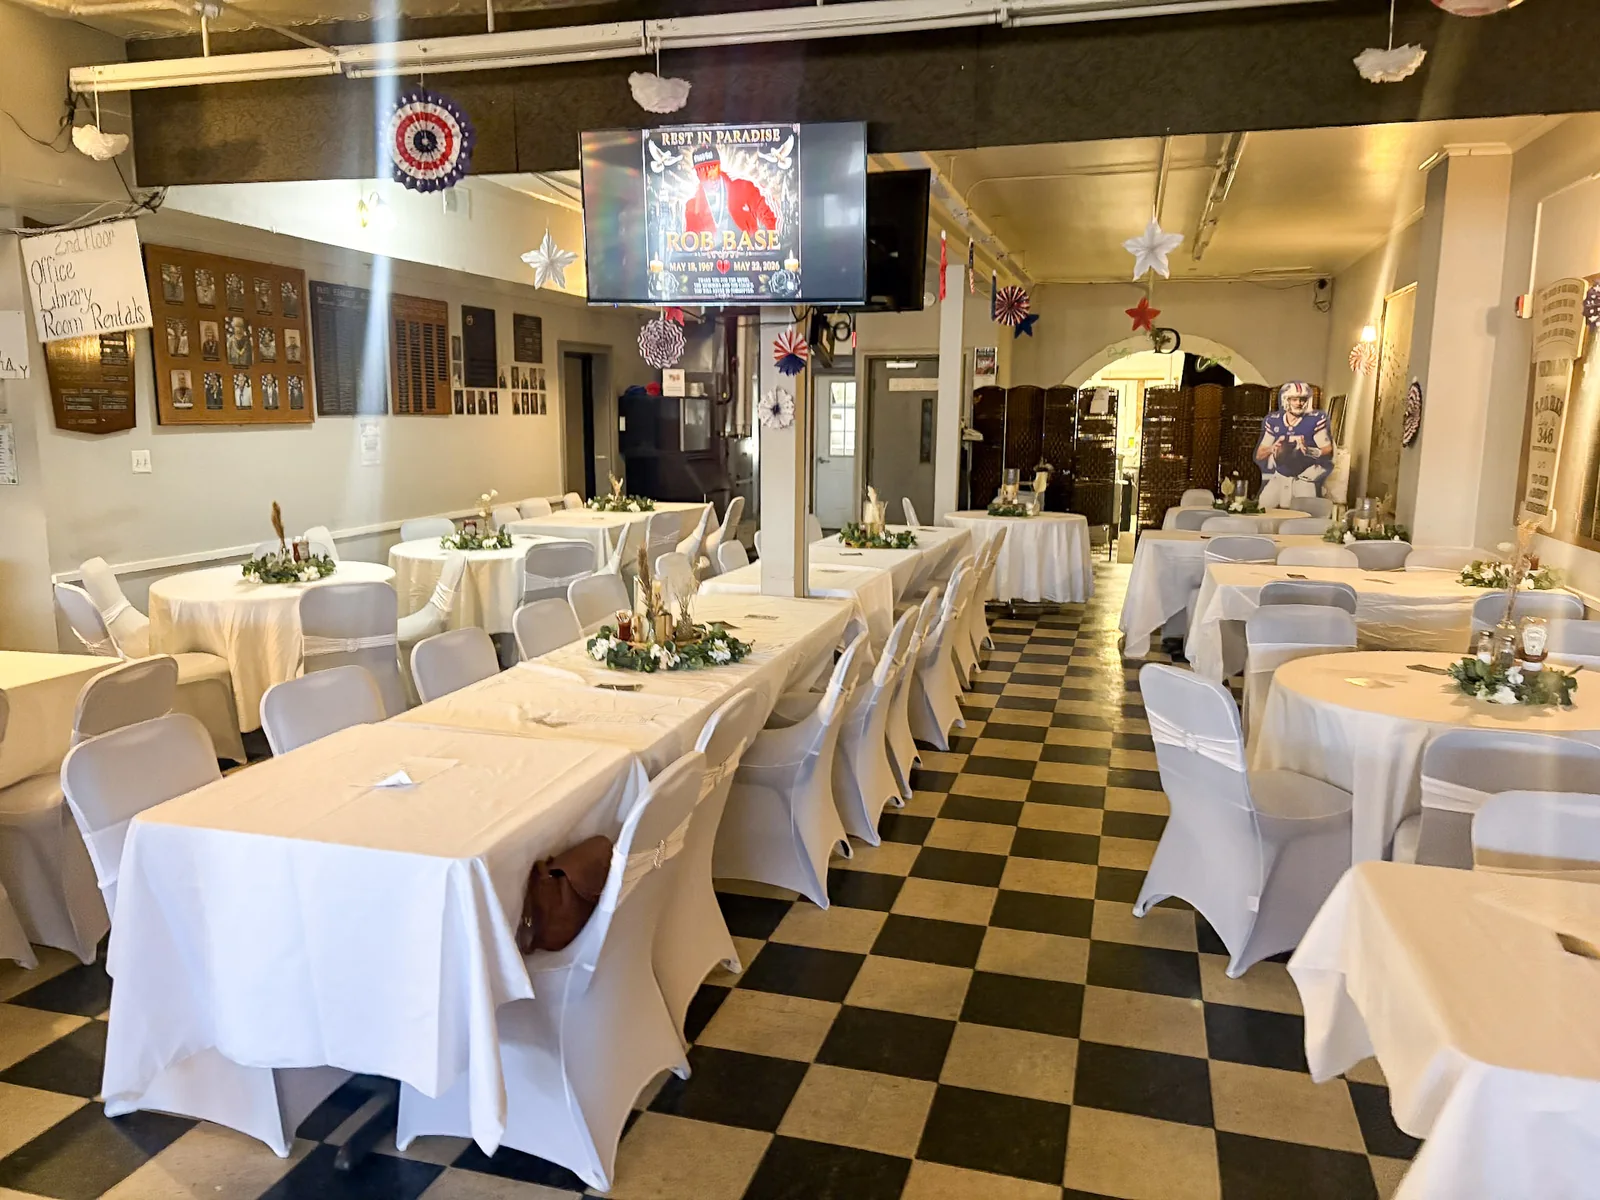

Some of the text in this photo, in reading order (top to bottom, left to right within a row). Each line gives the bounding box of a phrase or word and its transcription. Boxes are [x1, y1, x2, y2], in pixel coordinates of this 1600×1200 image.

[661, 128, 781, 146] REST IN PARADISE
[55, 229, 83, 255] 2nd
[666, 229, 781, 252] ROB BASE
[31, 256, 76, 285] Office
[669, 261, 686, 272] MAY
[699, 261, 714, 272] 1967
[733, 261, 751, 272] MAY
[763, 260, 780, 271] 2026
[39, 282, 92, 315] Library
[42, 296, 146, 338] Room Rentals
[1537, 427, 1554, 444] 346
